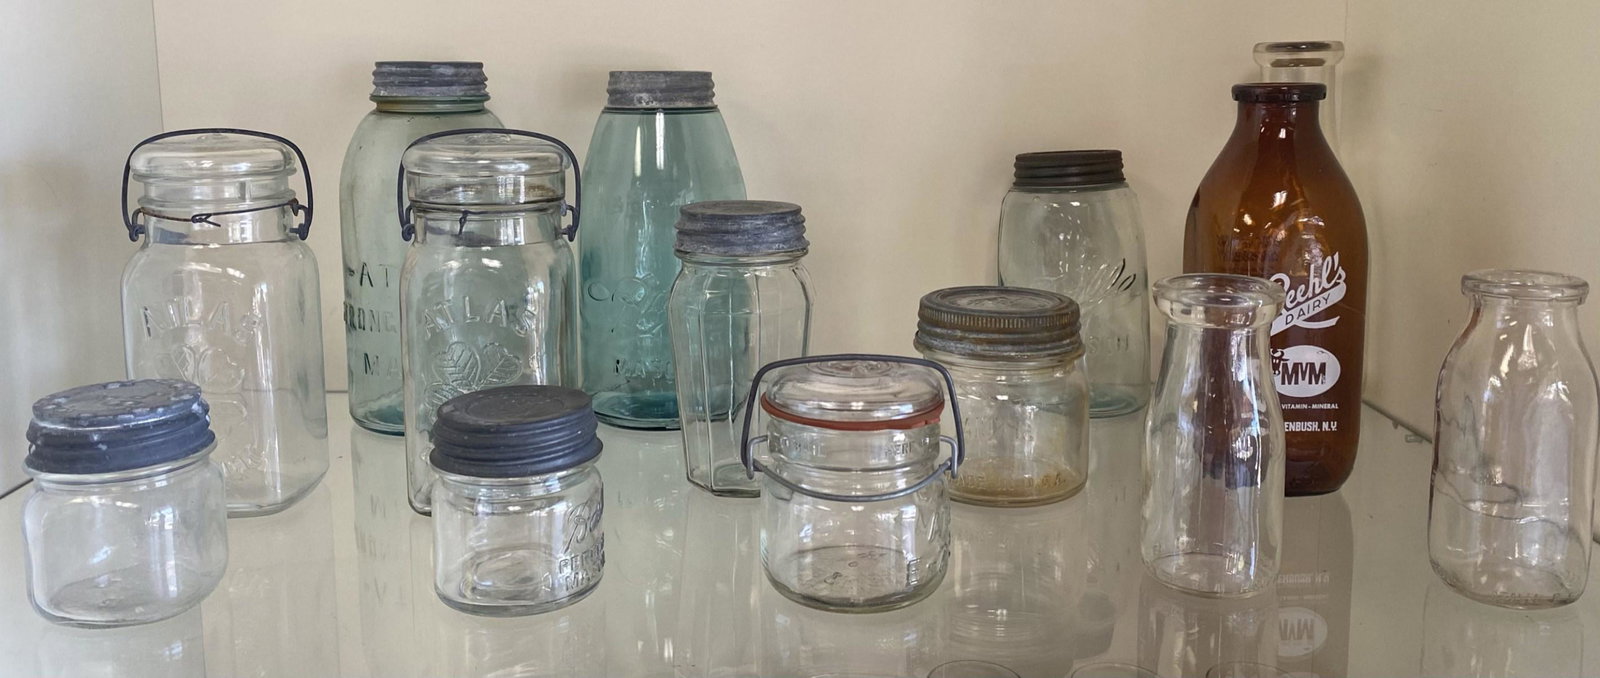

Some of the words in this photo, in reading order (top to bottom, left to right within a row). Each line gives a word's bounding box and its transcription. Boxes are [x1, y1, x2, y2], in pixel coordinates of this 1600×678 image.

[424, 295, 537, 340] ATLAS
[1284, 293, 1331, 326] DAIRY
[1280, 361, 1327, 386] MVM
